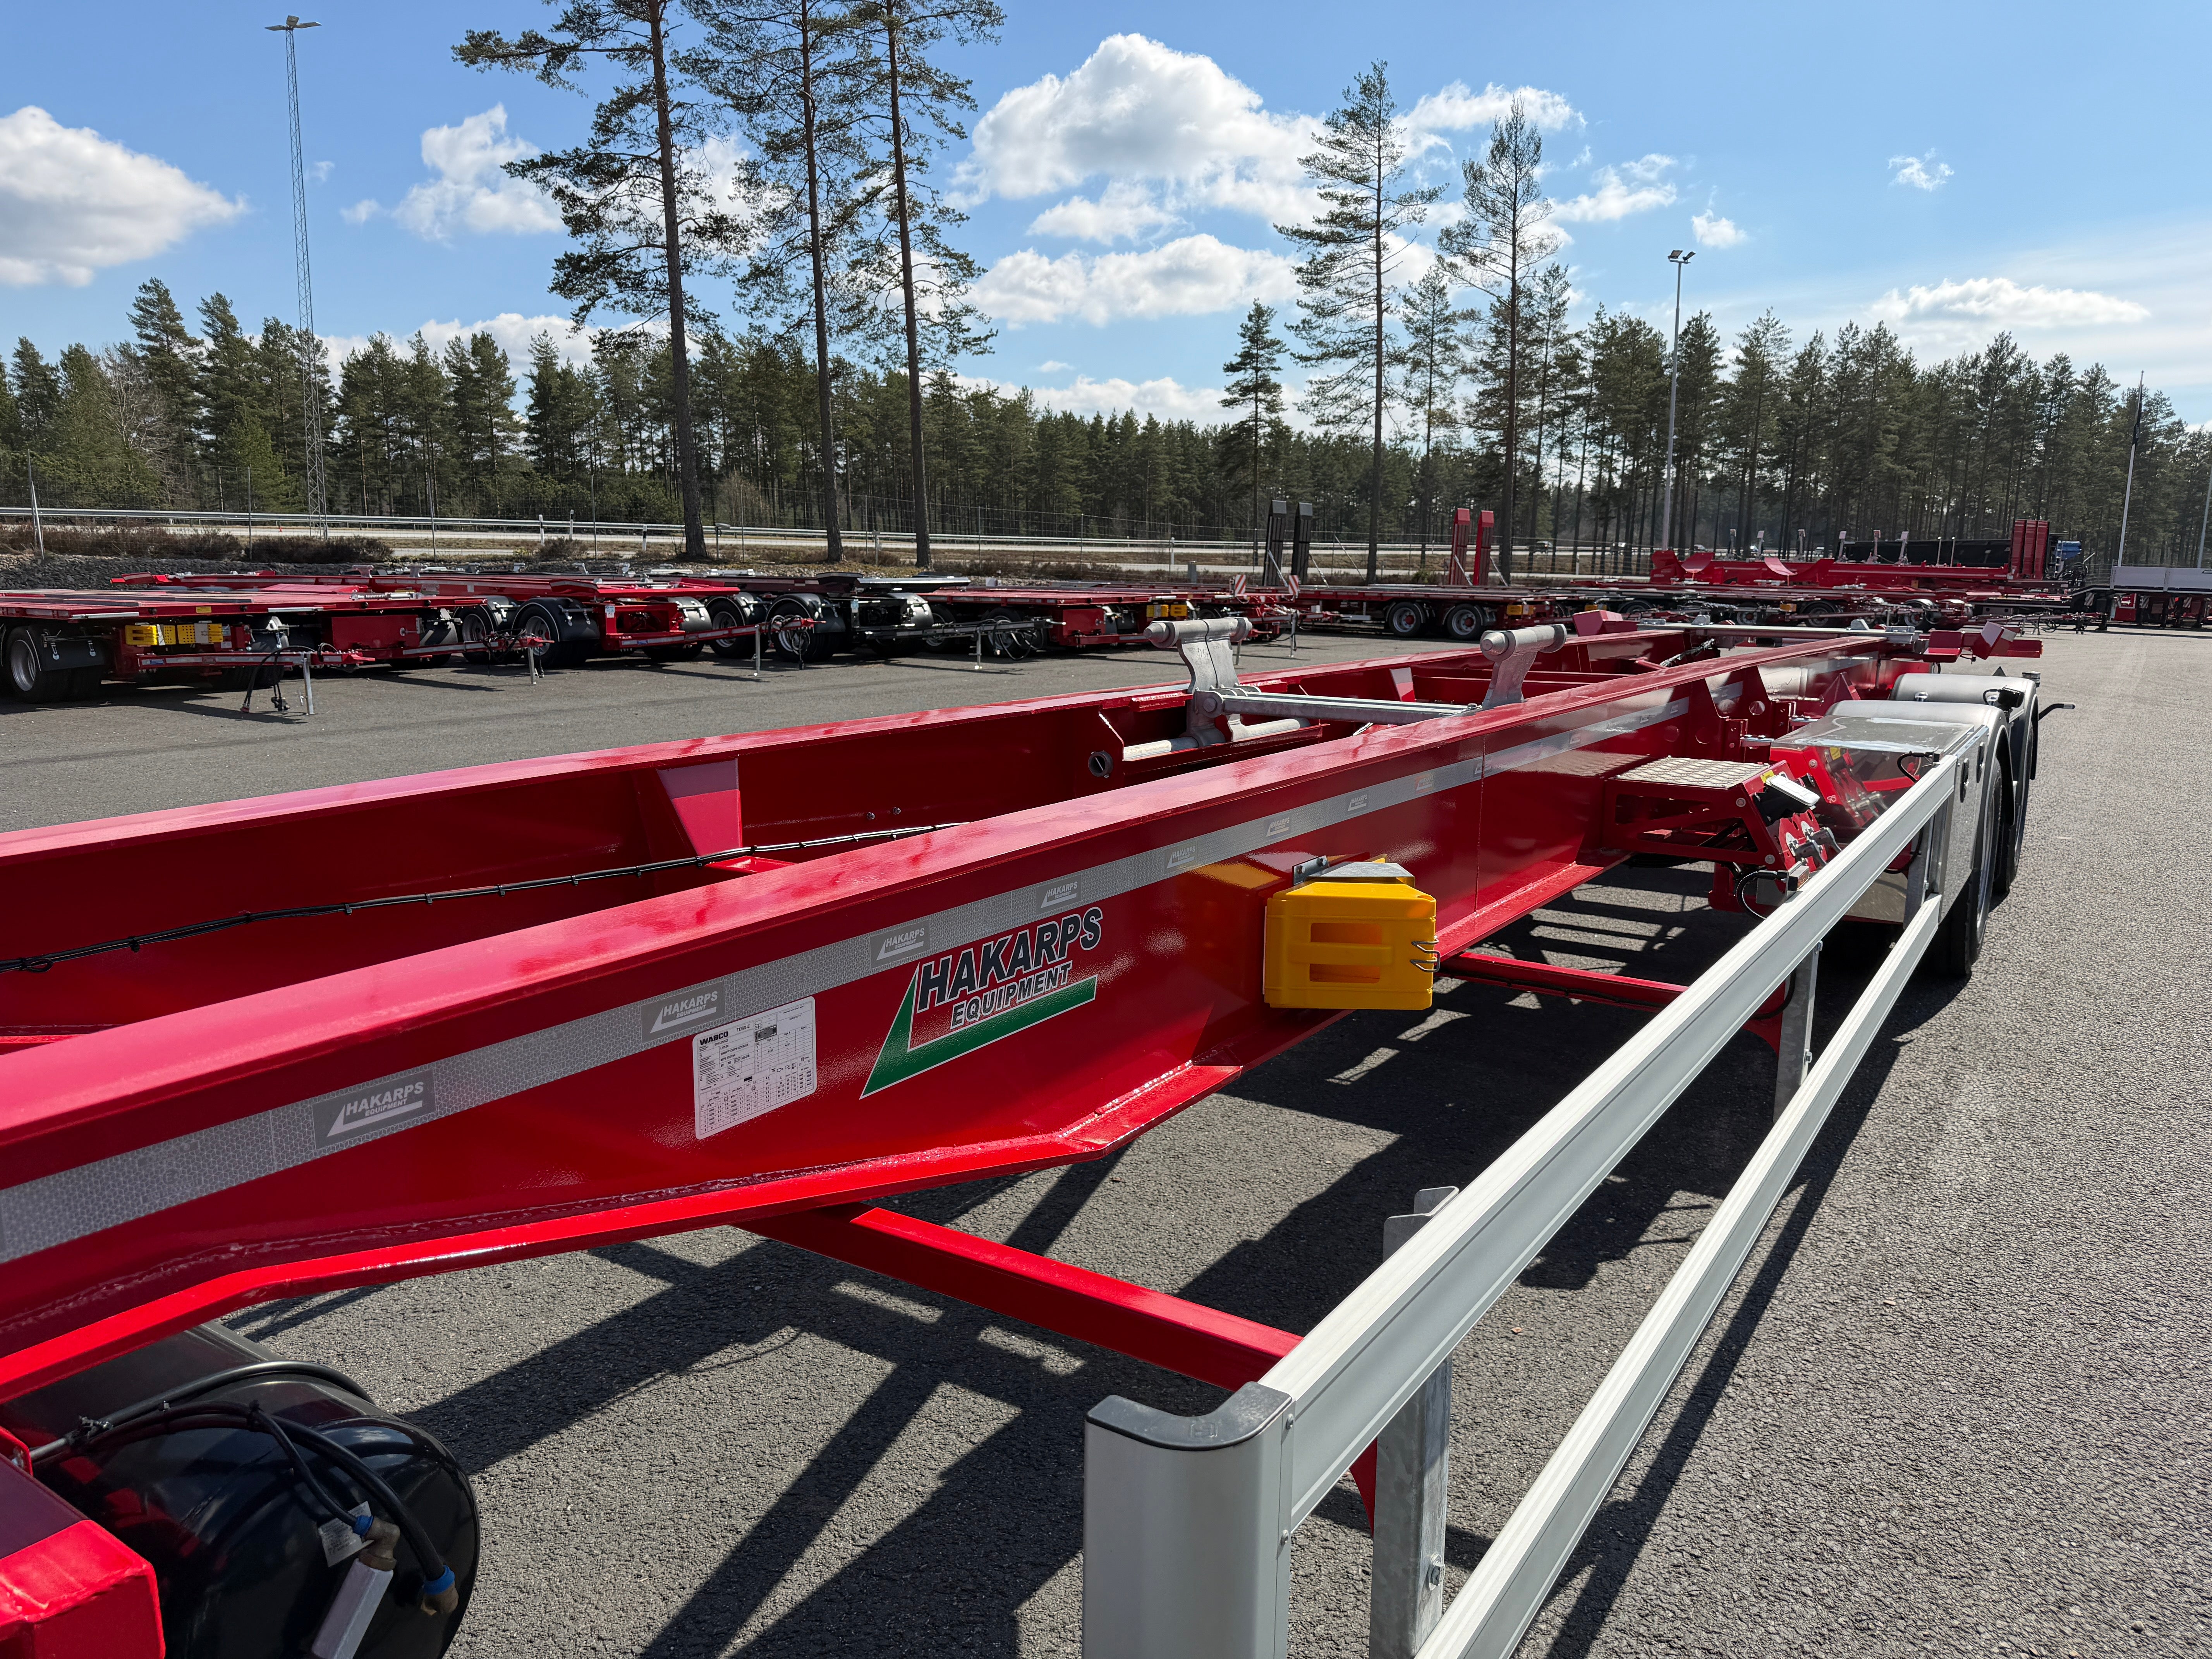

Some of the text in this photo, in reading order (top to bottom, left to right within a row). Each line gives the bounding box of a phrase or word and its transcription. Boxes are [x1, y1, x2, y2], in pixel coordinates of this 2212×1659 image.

[1048, 881, 1078, 897] HAKARPS
[886, 928, 925, 947] HAKARPS
[916, 907, 1103, 1014] HAKARPS
[663, 991, 718, 1017] HAKARPS
[950, 960, 1073, 1030] EQUIPMENT
[700, 1031, 728, 1046] WABCO
[346, 1082, 424, 1116] HAKARPS
[365, 1098, 407, 1117] EQUIPMENT
